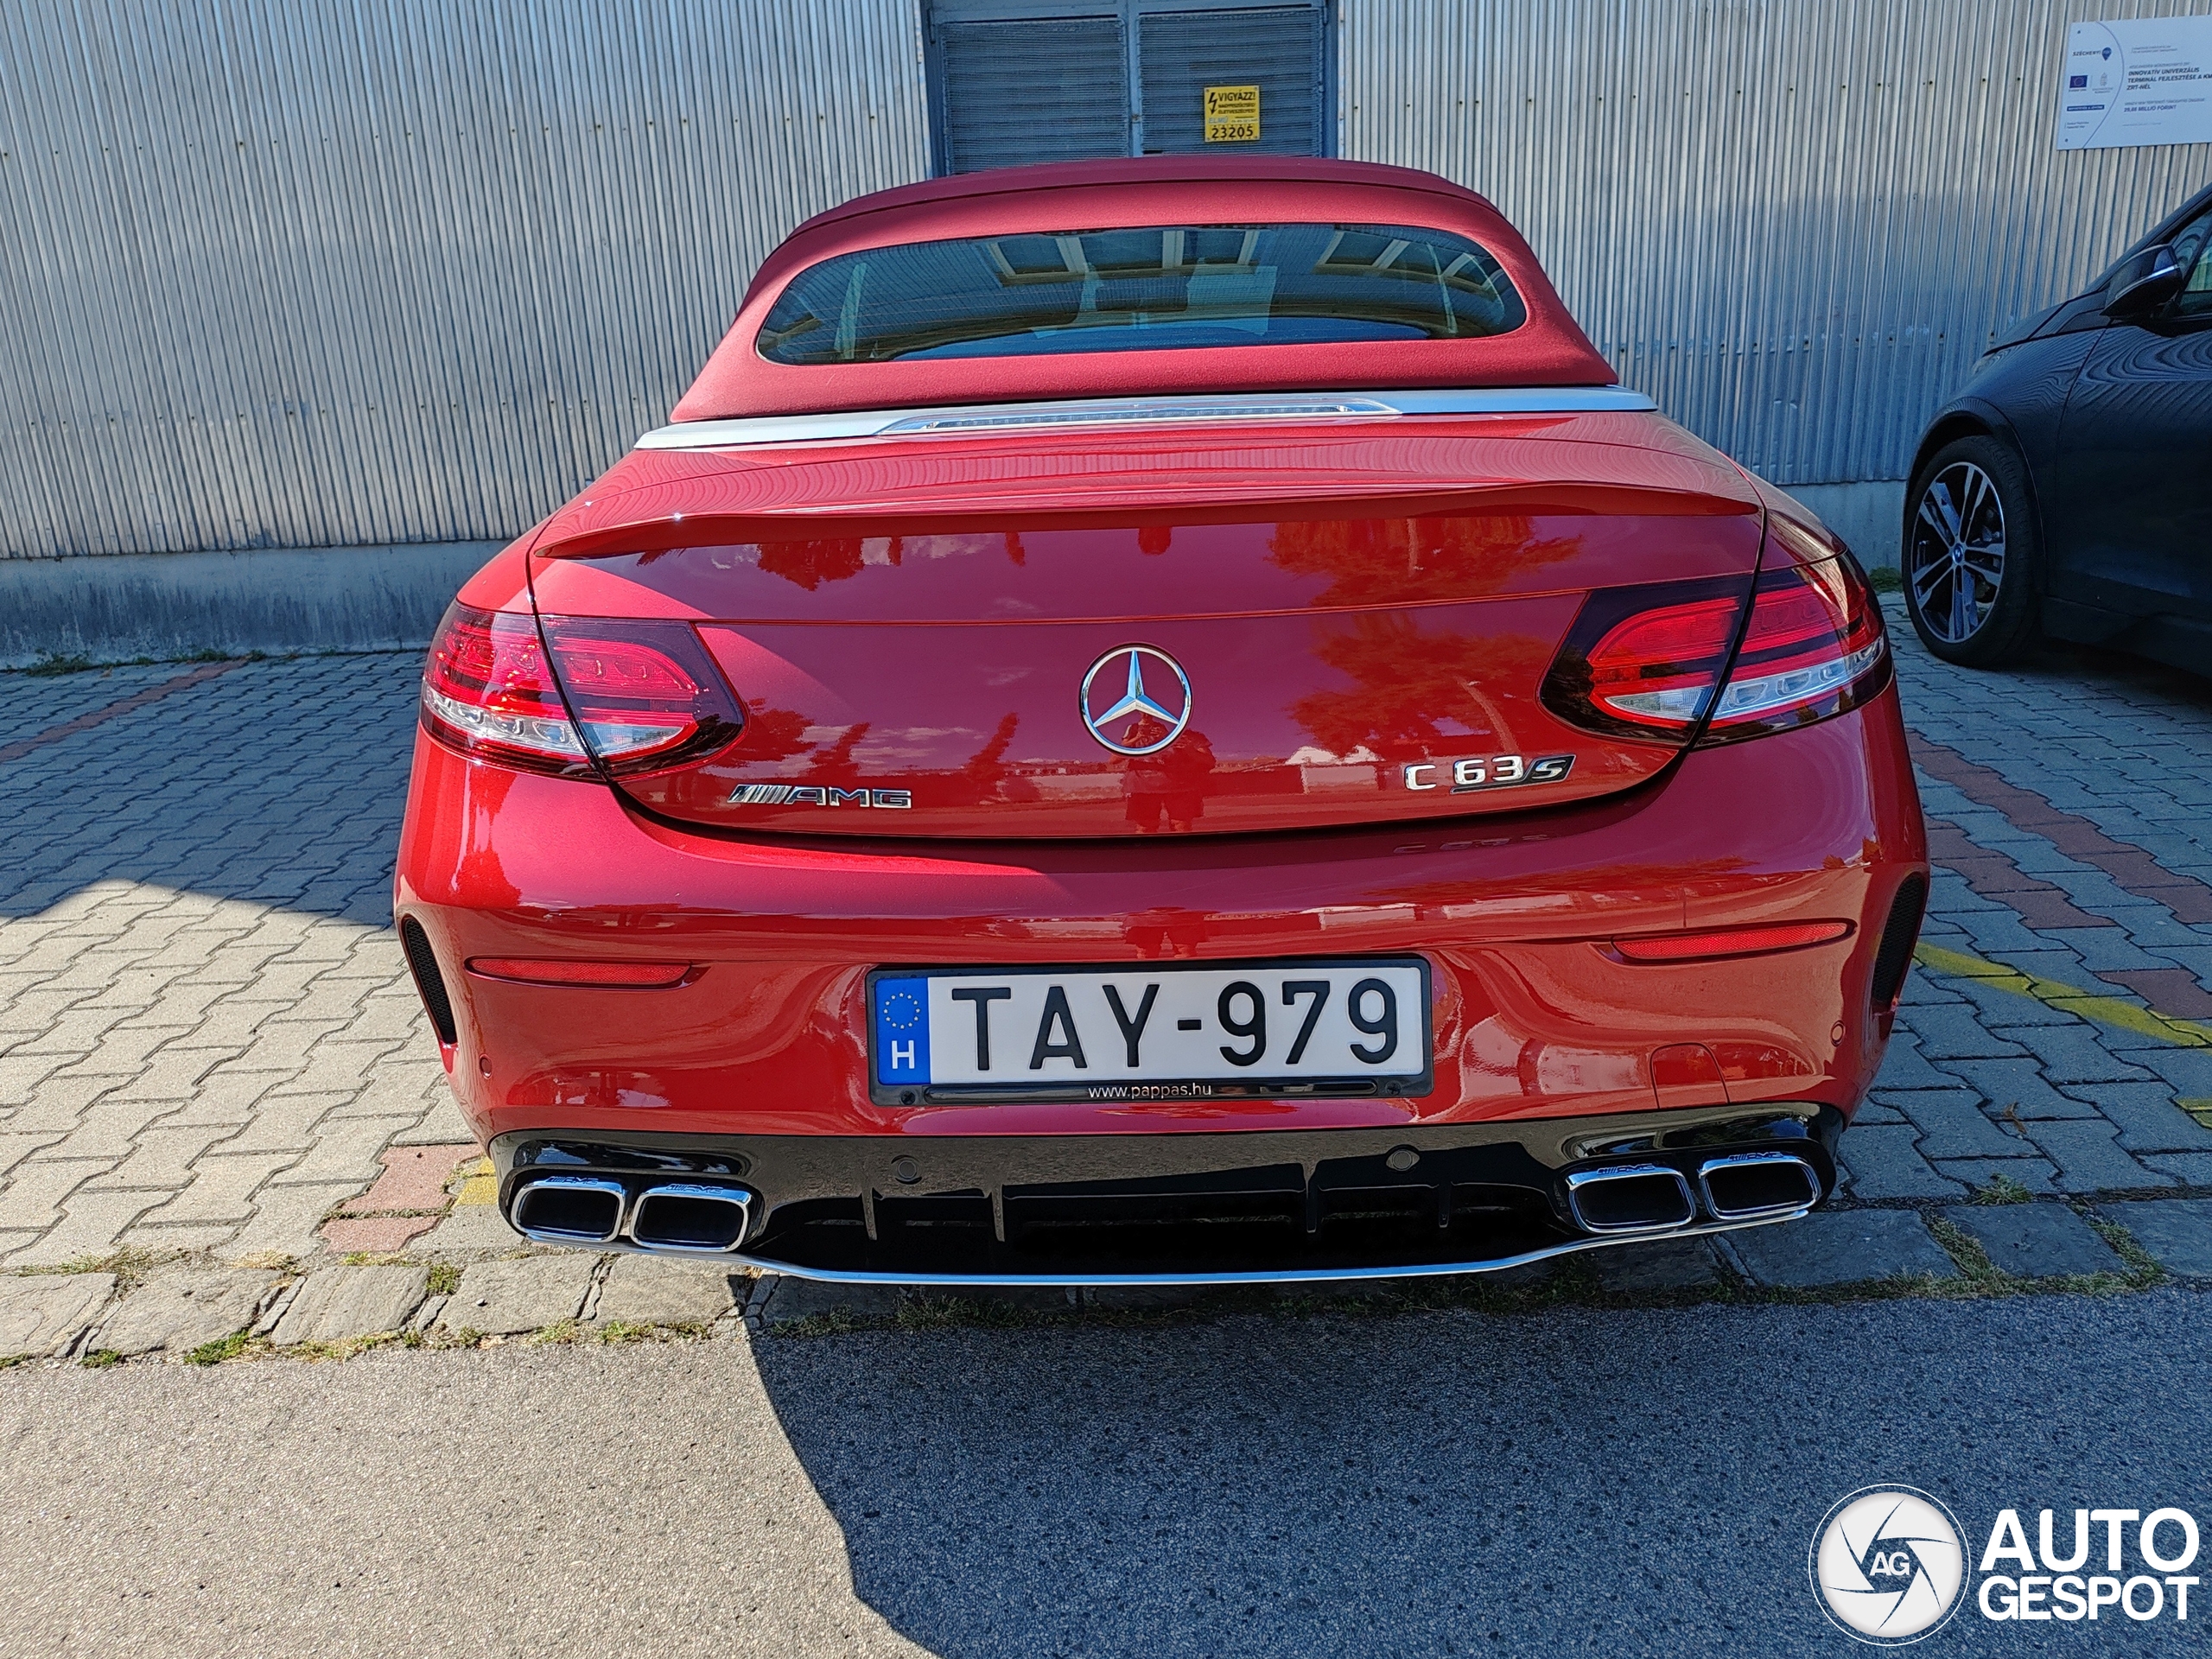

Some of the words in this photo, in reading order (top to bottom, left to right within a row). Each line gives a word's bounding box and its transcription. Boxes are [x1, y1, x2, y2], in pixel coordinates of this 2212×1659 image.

[2158, 73, 2196, 82] FEJLESZTÉSE
[1217, 90, 1255, 101] VIGYÁZZ!
[1211, 125, 1253, 138] 23205
[1404, 764, 1436, 791] C
[1453, 755, 1523, 785] 63
[784, 785, 912, 809] AMG
[951, 978, 1398, 1071] TAY-979
[892, 1039, 915, 1070] H
[1088, 1082, 1211, 1099] www.pappas.hu
